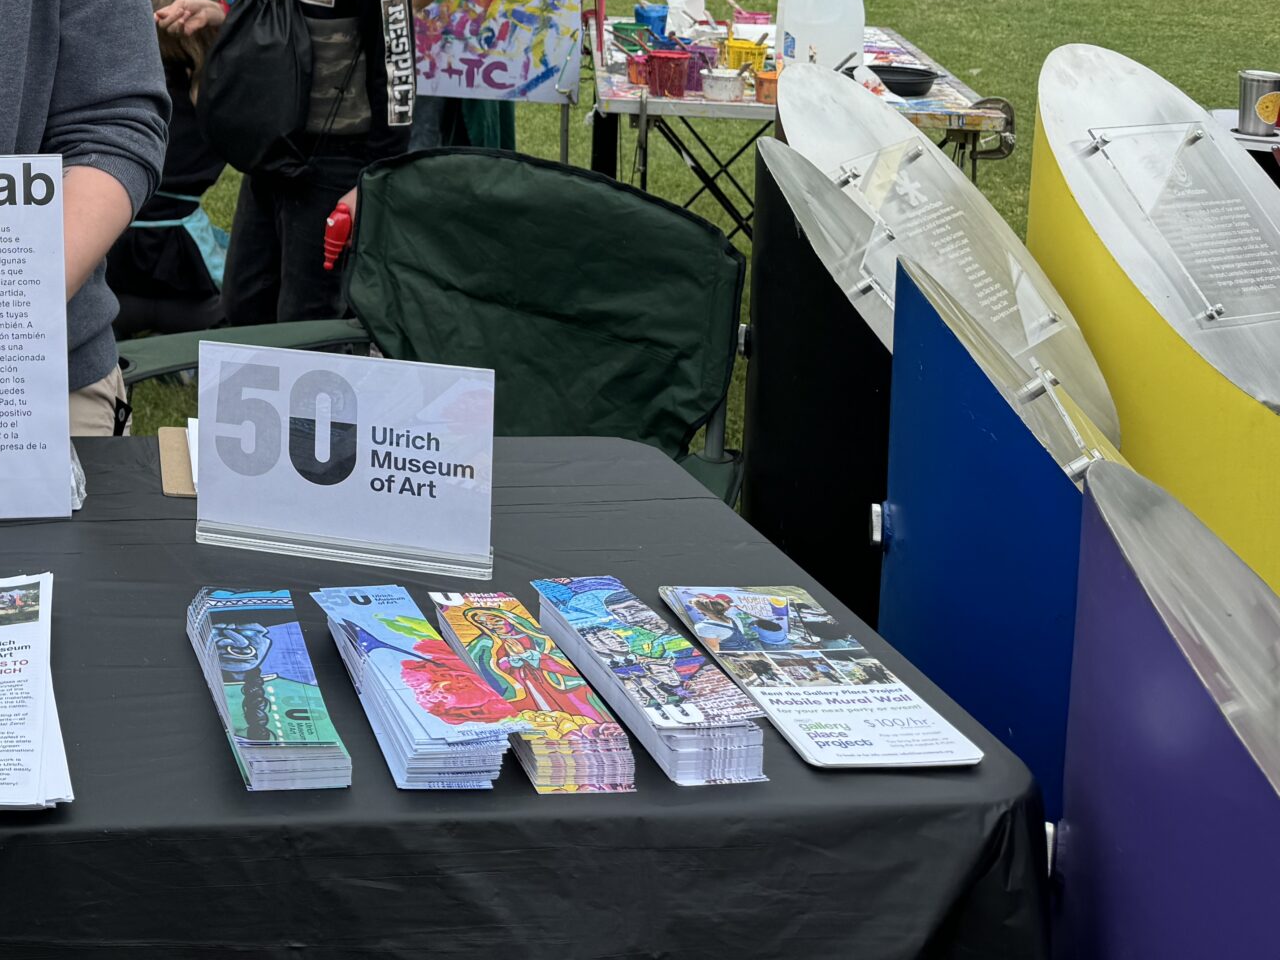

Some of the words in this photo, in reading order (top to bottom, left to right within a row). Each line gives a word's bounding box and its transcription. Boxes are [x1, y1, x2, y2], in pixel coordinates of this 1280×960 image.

[387, 3, 413, 117] RESPECT
[215, 360, 358, 486] 50
[371, 425, 440, 452] Ulrich
[370, 450, 475, 480] Museum
[370, 474, 395, 493] of
[399, 477, 437, 499] Art
[11, 658, 29, 666] TO
[803, 689, 840, 697] Gallery
[870, 687, 903, 695] Project
[768, 697, 822, 706] Mobile
[827, 696, 872, 705] Mural
[875, 693, 913, 703] Wall
[799, 721, 852, 731] gallery
[806, 729, 849, 740] place
[814, 737, 873, 749] project
